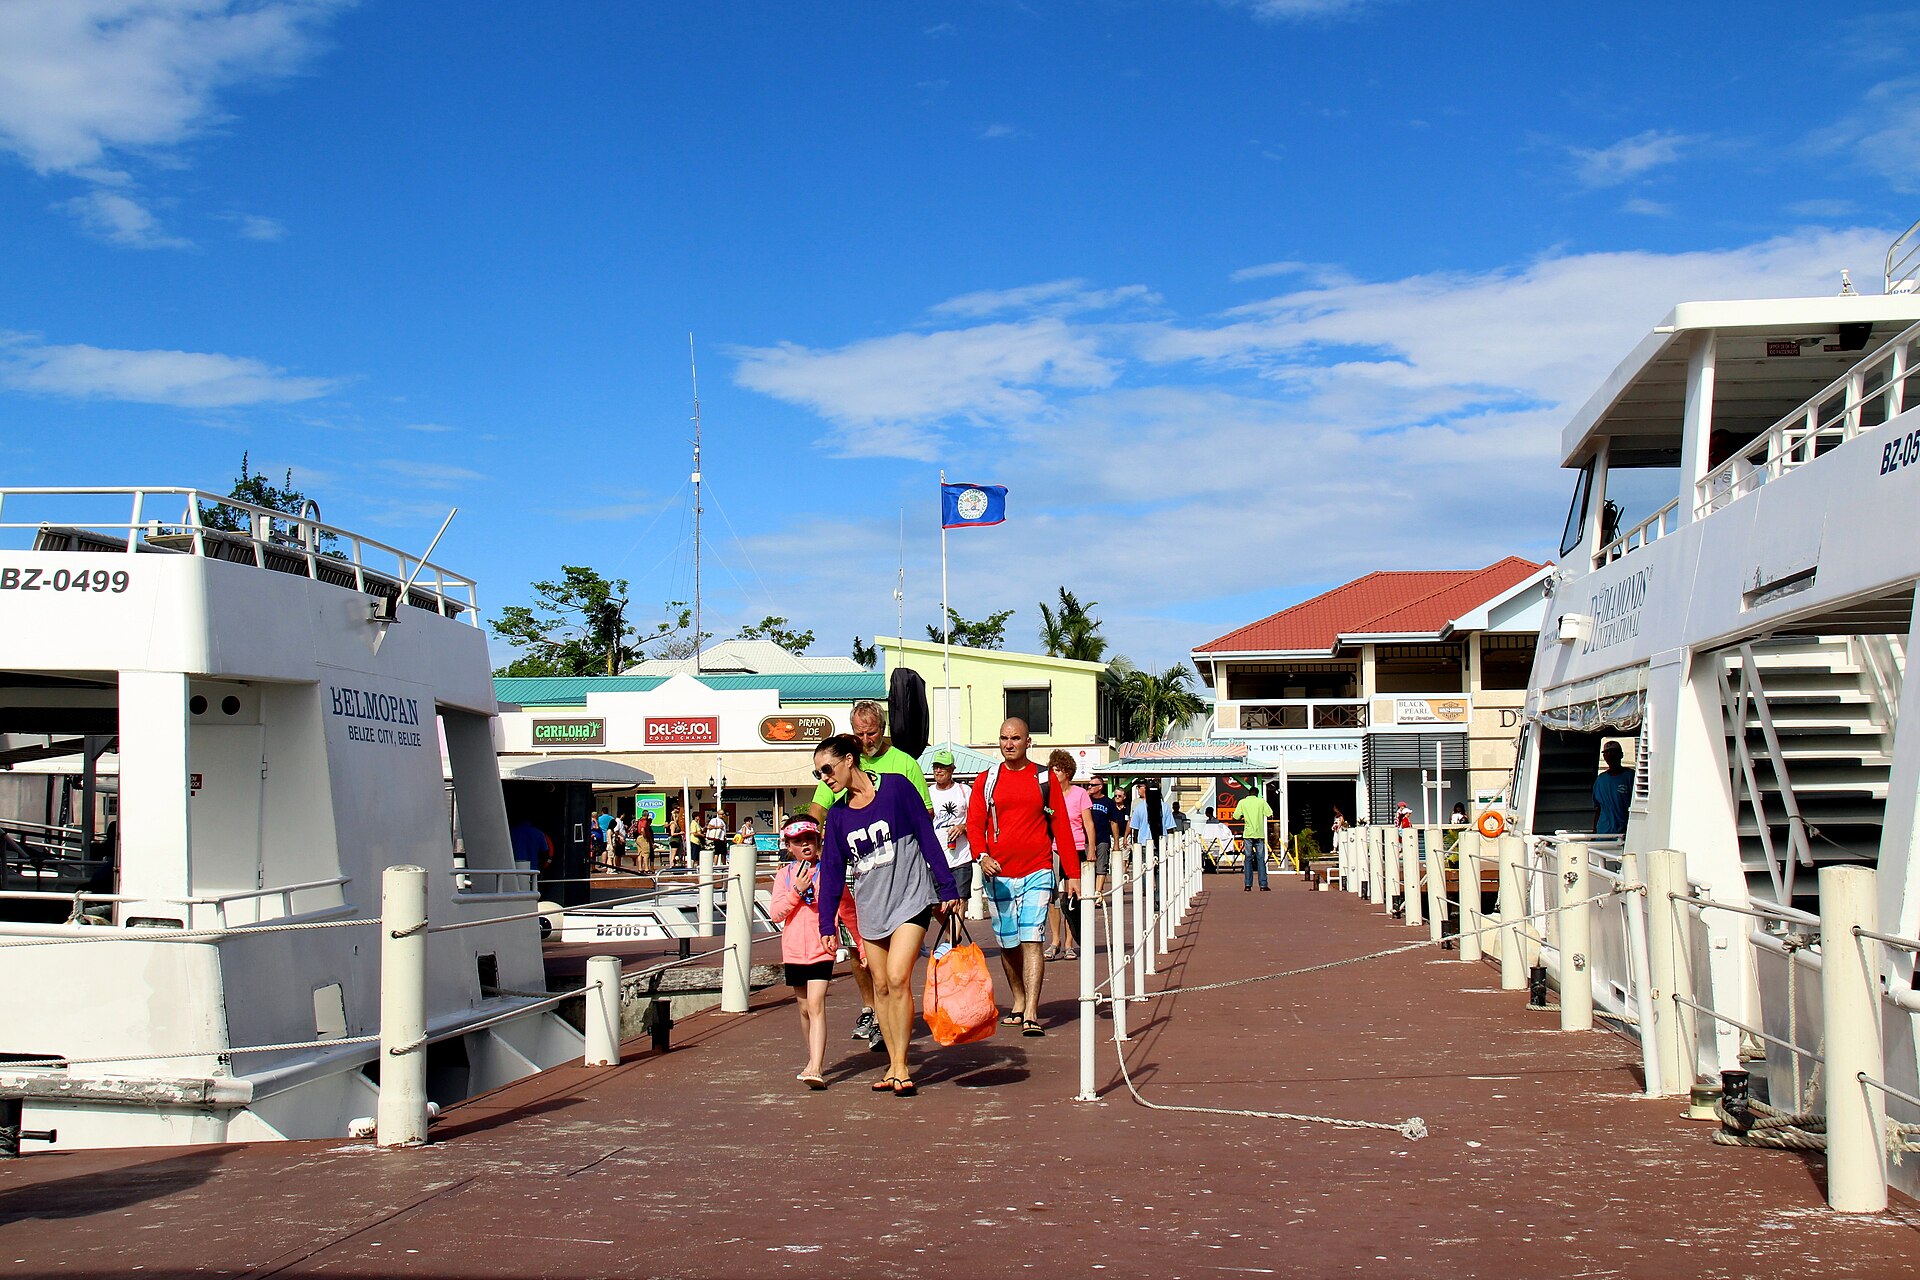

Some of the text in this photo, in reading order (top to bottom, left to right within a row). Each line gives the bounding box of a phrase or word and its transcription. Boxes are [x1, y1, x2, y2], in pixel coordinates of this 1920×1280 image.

[0, 568, 130, 593] BZ-0499
[330, 686, 419, 726] BELMOPAN
[348, 725, 422, 747] BELIZE CITY, BELIZE
[649, 722, 712, 736] DEL SOL
[803, 728, 820, 736] JOE
[1117, 739, 1175, 758] Welcome
[1309, 743, 1358, 751] PERFUMES
